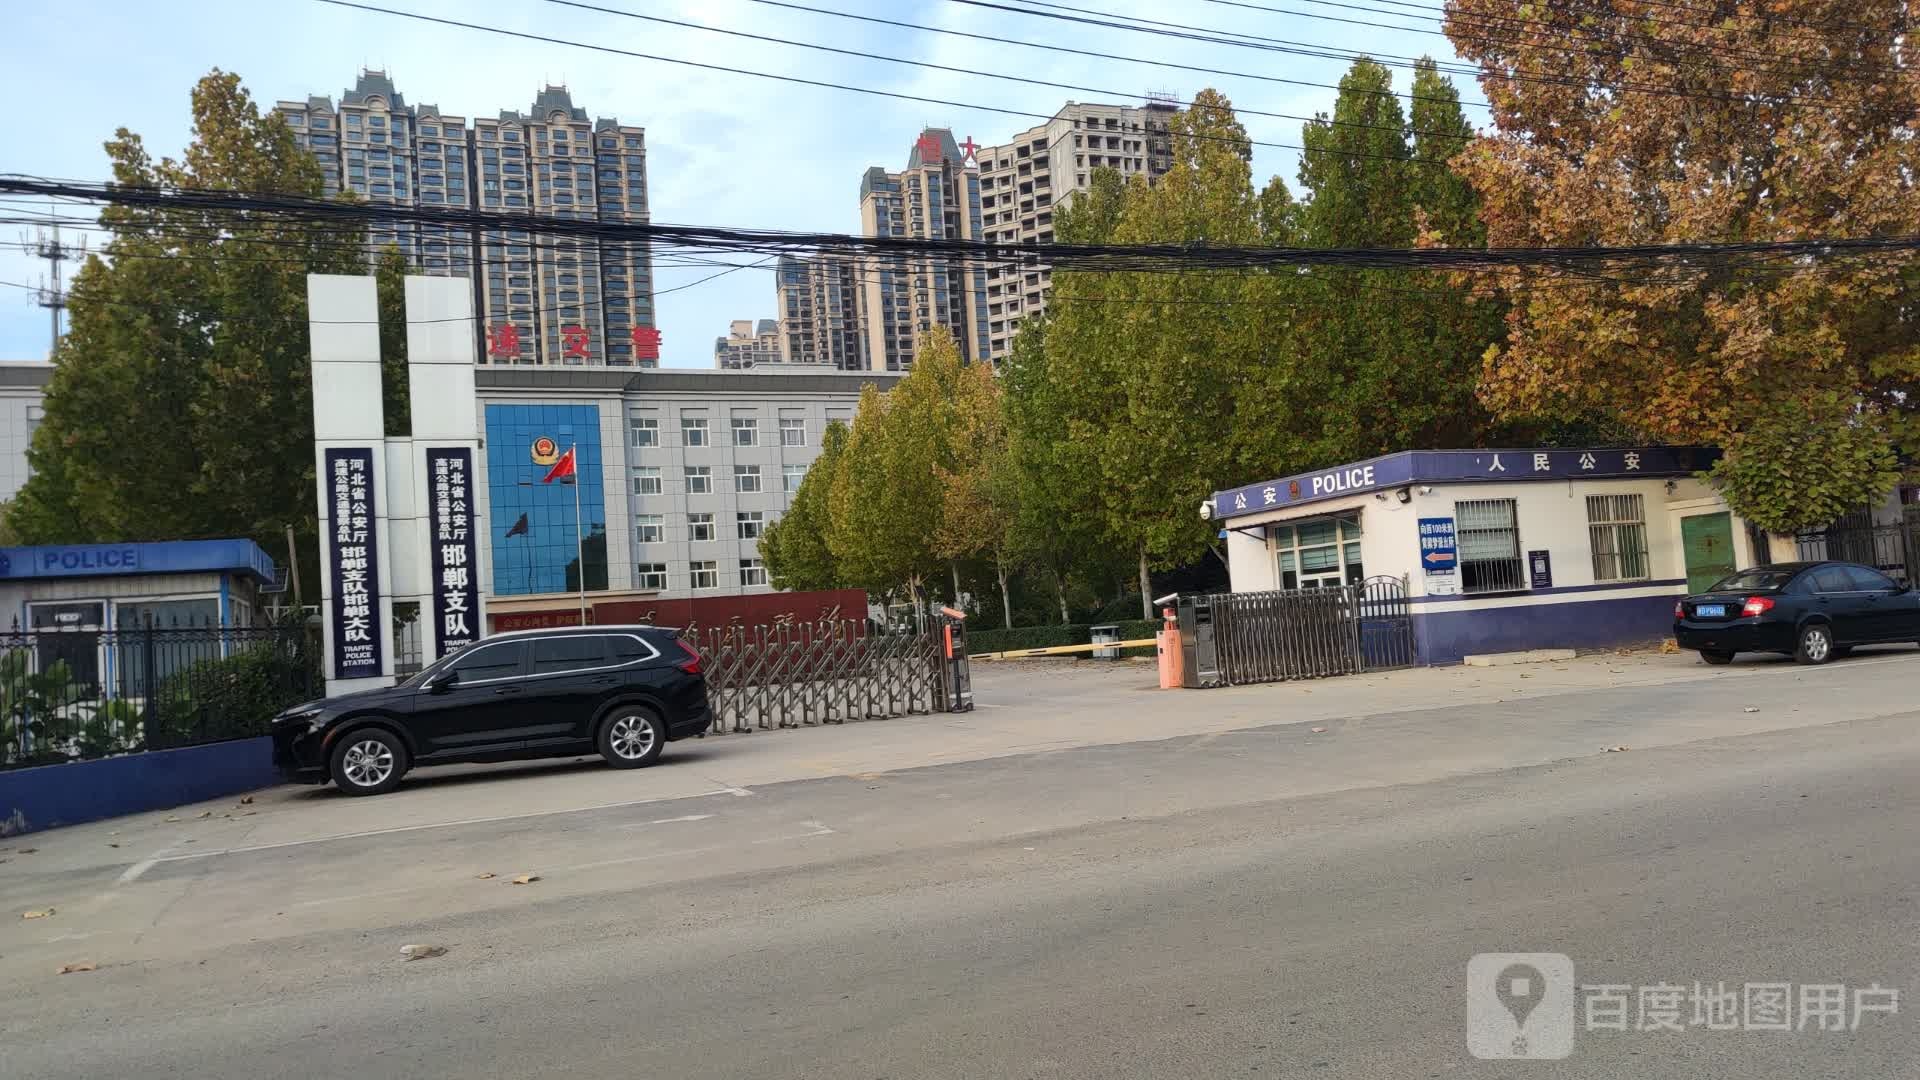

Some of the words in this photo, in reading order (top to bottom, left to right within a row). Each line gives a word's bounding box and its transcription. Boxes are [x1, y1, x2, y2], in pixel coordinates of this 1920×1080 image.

[335, 459, 351, 542] 高速公路交通警察总队
[350, 459, 368, 542] 河北省公安厅
[435, 458, 451, 540] 高速公路交通警察总队
[450, 458, 467, 540] 河北省公安厅
[1235, 487, 1277, 509] 公安
[1312, 466, 1375, 495] POLICE
[1489, 453, 1641, 471] 人民公安
[45, 550, 136, 570] POLICE
[340, 546, 371, 641] 邯郸支队邯郸大队
[441, 544, 470, 636] 邯郸支队
